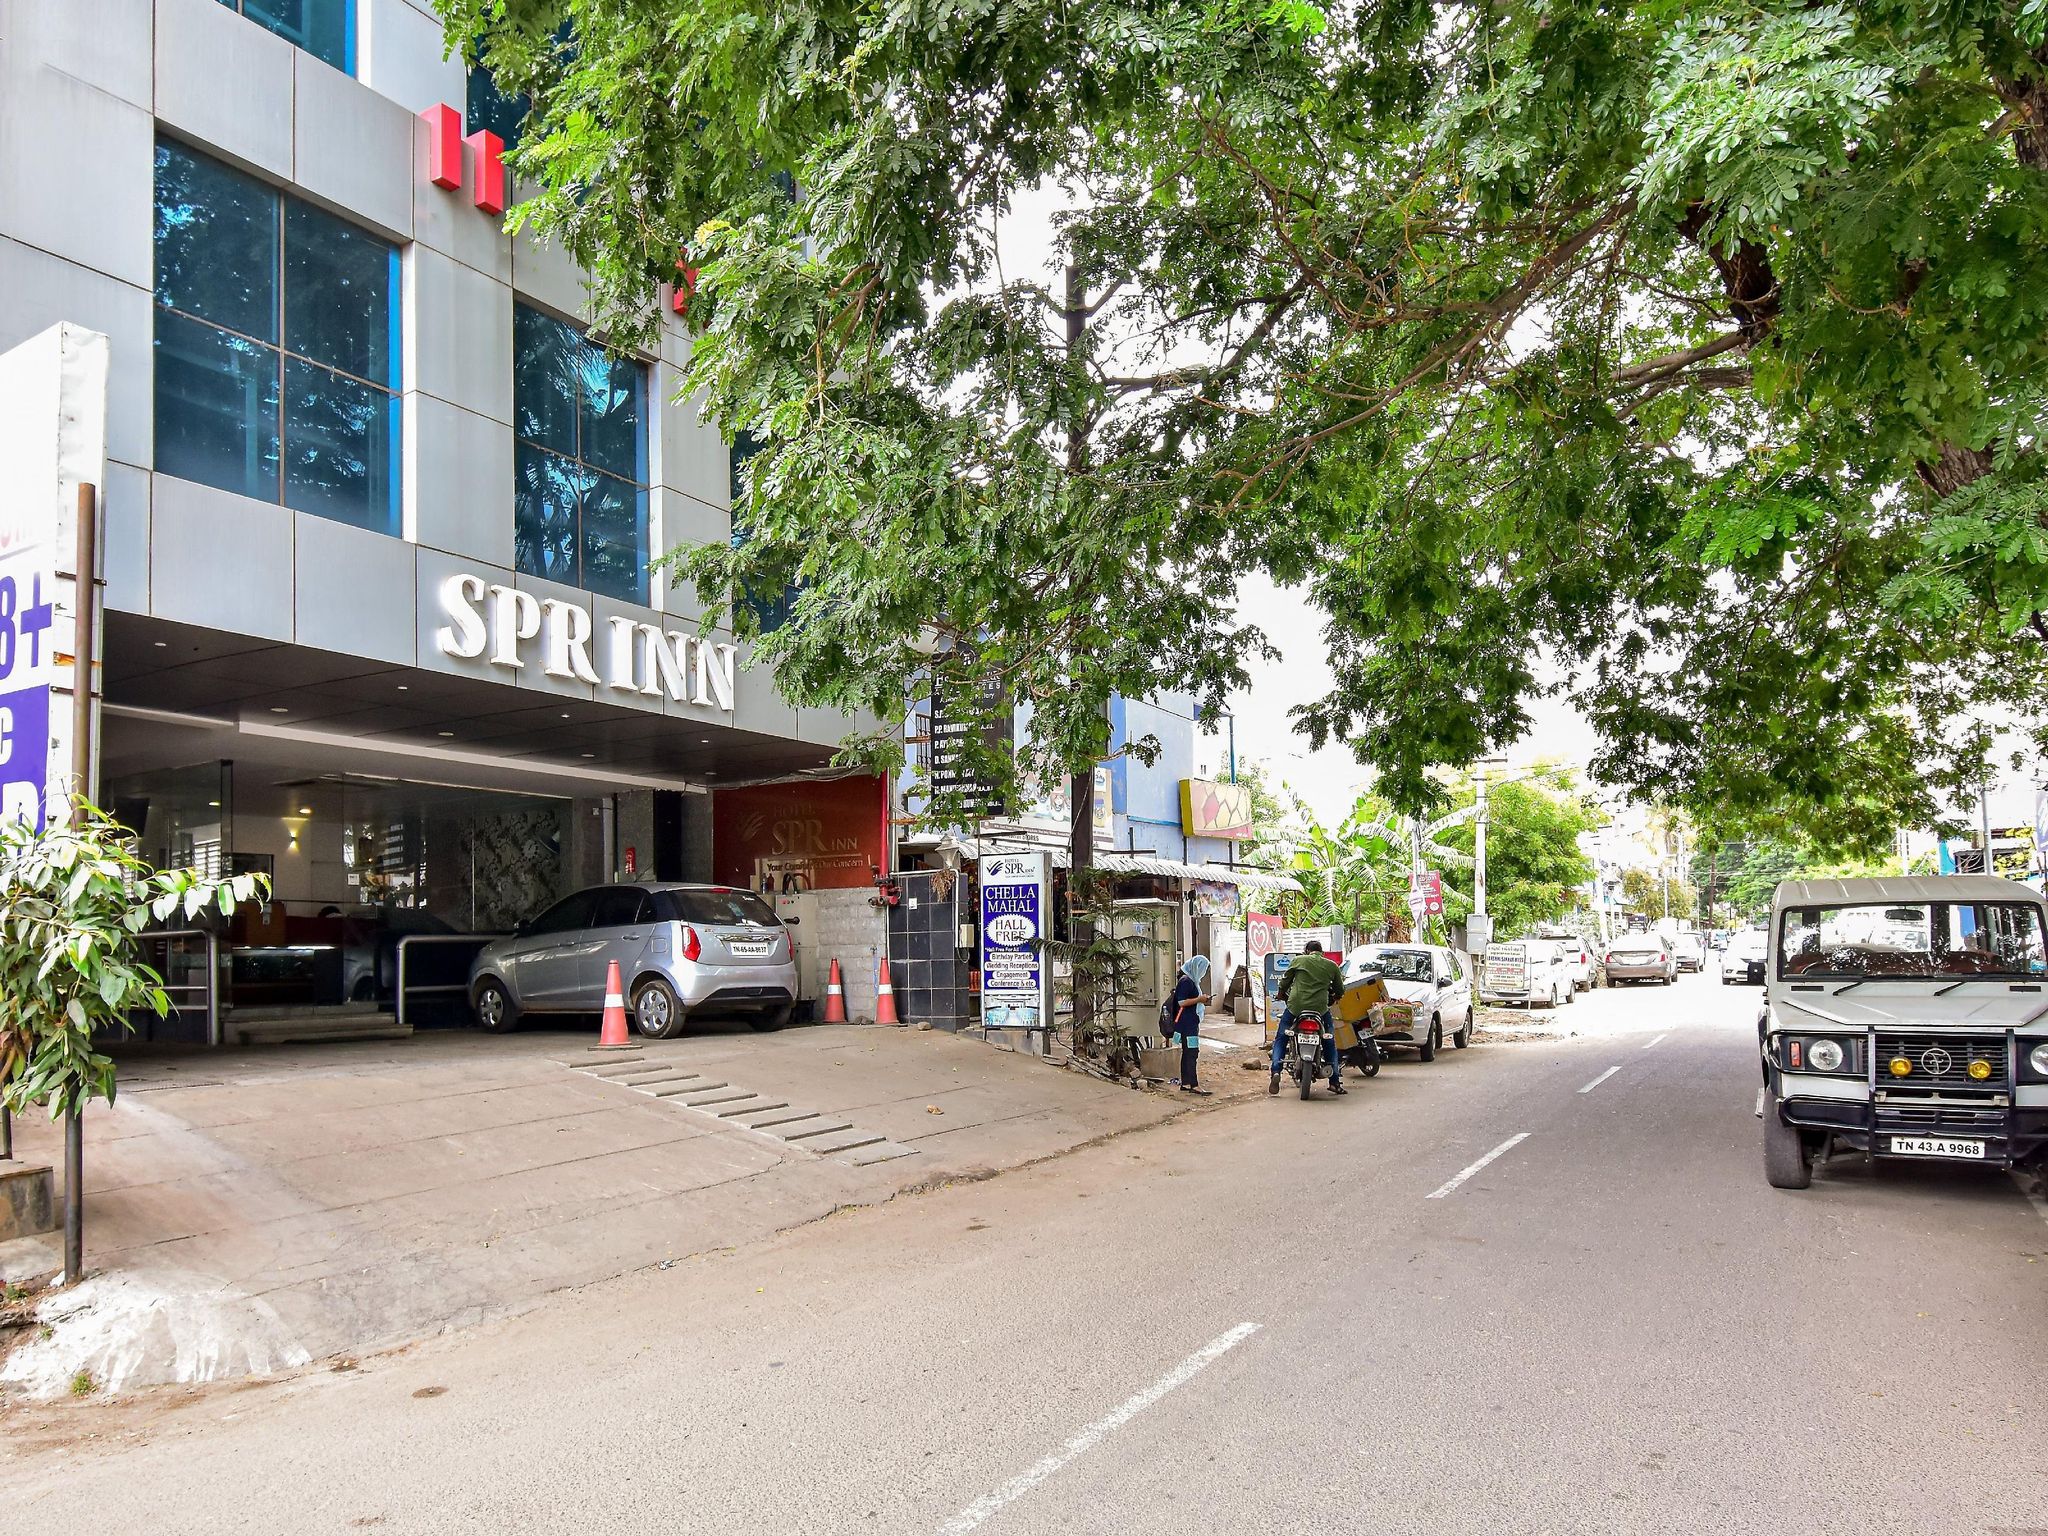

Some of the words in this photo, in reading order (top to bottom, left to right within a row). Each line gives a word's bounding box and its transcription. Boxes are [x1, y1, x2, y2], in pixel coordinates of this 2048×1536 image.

[436, 573, 600, 684] SPR
[608, 616, 738, 711] INN
[771, 819, 829, 855] SPR
[831, 837, 858, 851] INN
[767, 863, 783, 871] Your
[1004, 863, 1025, 874] SPR
[986, 886, 1036, 900] CHELLA
[987, 900, 1034, 913] MAHAL
[995, 919, 1027, 930] HALL
[995, 930, 1026, 942] FREE
[991, 953, 1013, 961] Birthday
[987, 962, 1009, 970] Wedding
[997, 971, 1028, 979] Engagement
[1897, 1141, 1914, 1150] TN
[1949, 1143, 1980, 1155] 9968
